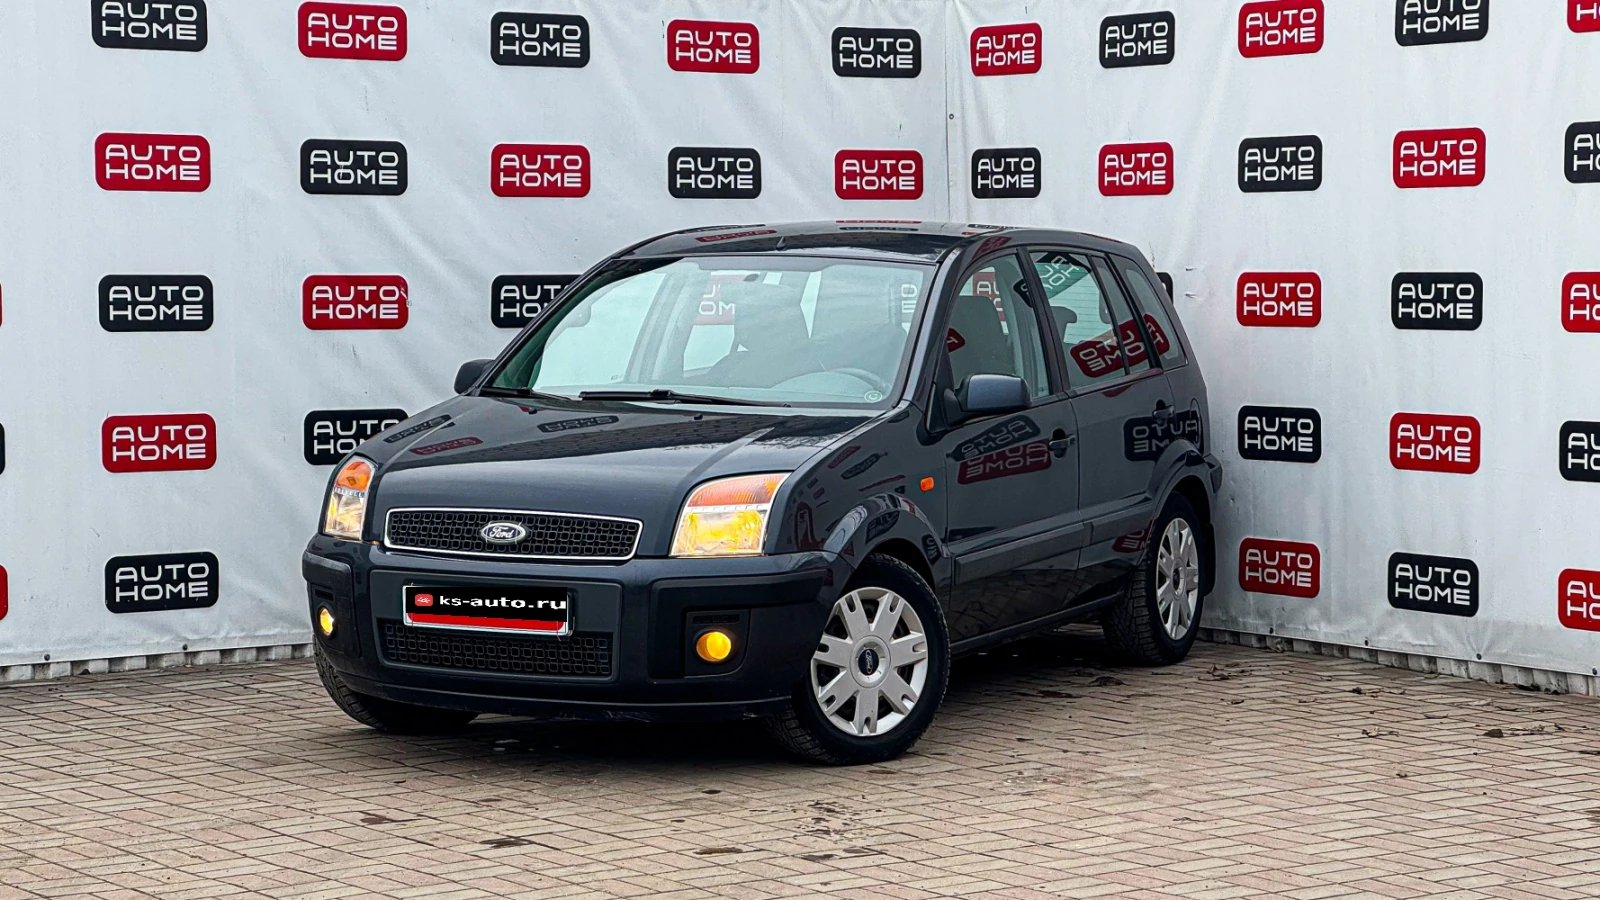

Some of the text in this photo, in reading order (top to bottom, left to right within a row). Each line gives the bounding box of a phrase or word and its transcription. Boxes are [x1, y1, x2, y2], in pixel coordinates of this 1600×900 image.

[102, 2, 197, 21] AUTO
[1246, 8, 1316, 28] AUTO
[308, 13, 398, 31] AUTO
[1403, 13, 1479, 34] HOME
[102, 21, 196, 40] HOME
[500, 23, 581, 39] AUTO
[676, 30, 751, 46] AUTO
[1106, 22, 1168, 40] AUTO
[1246, 27, 1315, 46] HOME
[308, 31, 396, 50] HOME
[500, 40, 580, 57] HOME
[840, 37, 913, 52] AUTO
[977, 33, 1035, 49] AUTO
[1105, 39, 1167, 58] HOME
[676, 47, 751, 63] HOME
[840, 54, 912, 68] HOME
[976, 50, 1034, 66] HOME
[106, 144, 200, 161] AUTO
[1245, 146, 1314, 163] AUTO
[1401, 140, 1477, 157] AUTO
[311, 150, 398, 167] AUTO
[501, 155, 582, 169] AUTO
[677, 157, 753, 171] AUTO
[843, 160, 915, 173] AUTO
[978, 158, 1035, 172] AUTO
[1105, 153, 1166, 168] AUTO
[106, 164, 200, 180] HOME
[311, 167, 397, 184] HOME
[1245, 165, 1313, 181] HOME
[1400, 159, 1475, 176] HOME
[500, 172, 581, 187] HOME
[677, 174, 753, 188] HOME
[843, 176, 914, 189] HOME
[978, 174, 1034, 188] HOME
[1105, 170, 1165, 185] HOME
[110, 286, 203, 301] AUTO
[313, 286, 399, 300] AUTO
[500, 285, 569, 300] AUT
[1244, 283, 1313, 297] AUTO
[1399, 284, 1474, 299] AUTO
[110, 305, 202, 320] HOME
[313, 304, 398, 319] HOME
[500, 303, 548, 317] HO
[1244, 301, 1312, 316] HOME
[1399, 303, 1473, 319] HOME
[1245, 417, 1313, 433] AUTO
[113, 425, 206, 442] AUTO
[1398, 424, 1471, 443] AUTO
[313, 439, 371, 454] HO
[1245, 434, 1312, 452] HOME
[113, 444, 205, 461] HOME
[1397, 443, 1470, 462] HOME
[1246, 548, 1313, 568] AUTO
[116, 563, 209, 583] AUTO
[1246, 566, 1312, 588] HOME
[1396, 564, 1470, 585] AUTO
[116, 582, 208, 602] HOME
[1396, 582, 1469, 605] HOME
